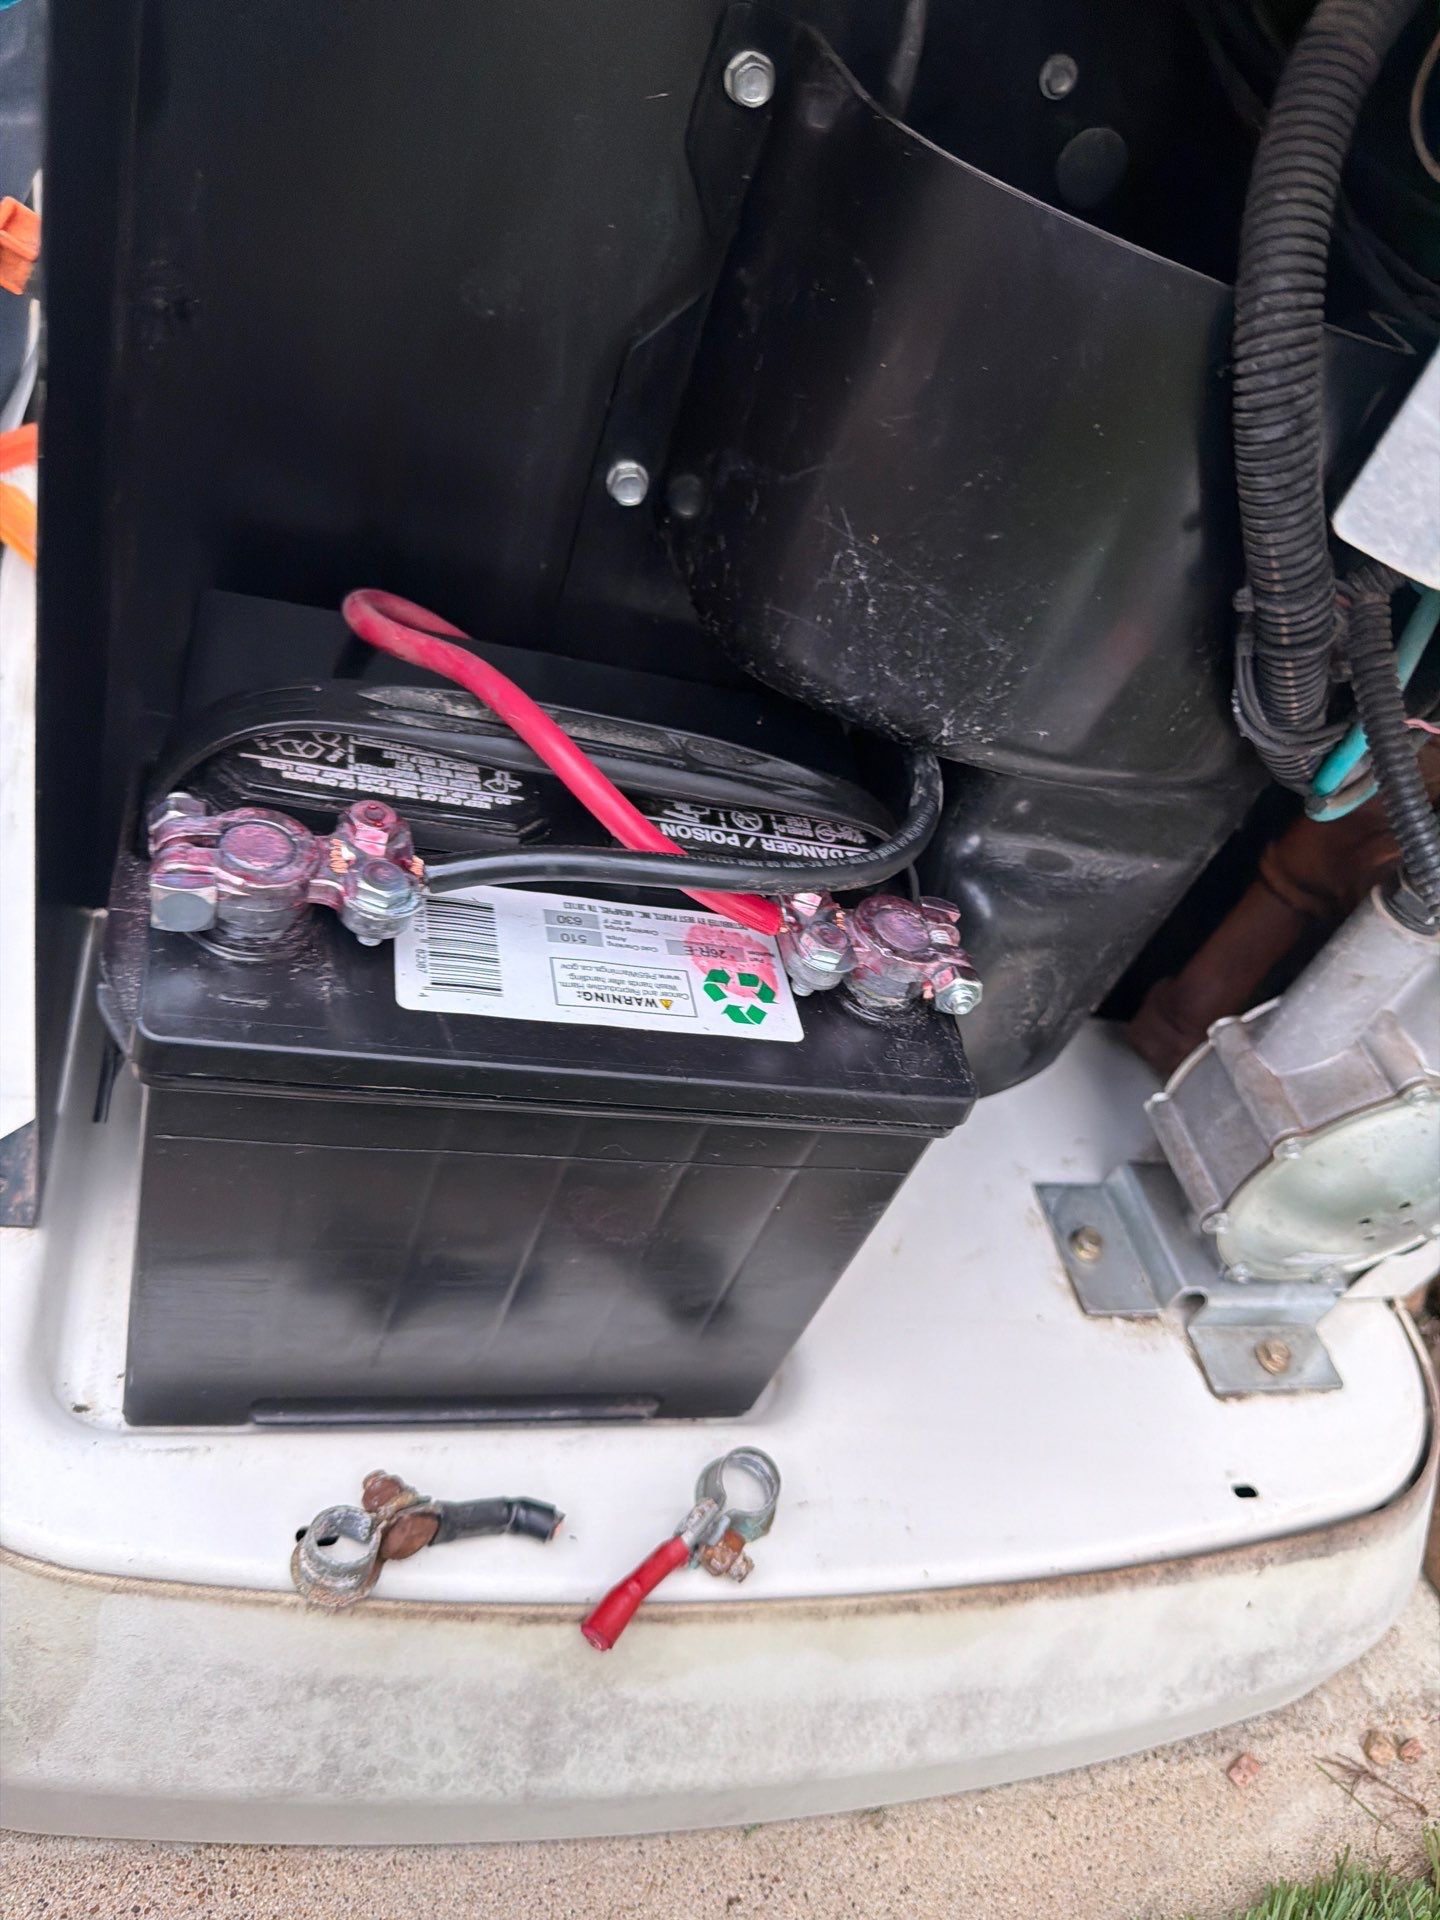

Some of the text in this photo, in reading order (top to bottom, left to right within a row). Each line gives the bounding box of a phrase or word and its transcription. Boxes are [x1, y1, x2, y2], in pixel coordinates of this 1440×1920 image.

[659, 822, 740, 848] POISON
[760, 837, 844, 860] DANGER
[556, 914, 583, 925] 630
[560, 932, 587, 943] 510
[683, 945, 728, 959] 26R-E
[586, 983, 640, 996] Reproductive
[654, 983, 678, 991] Wash
[576, 991, 658, 1008] WARNING:
[642, 989, 658, 998] and
[660, 991, 689, 1000] Cancer
